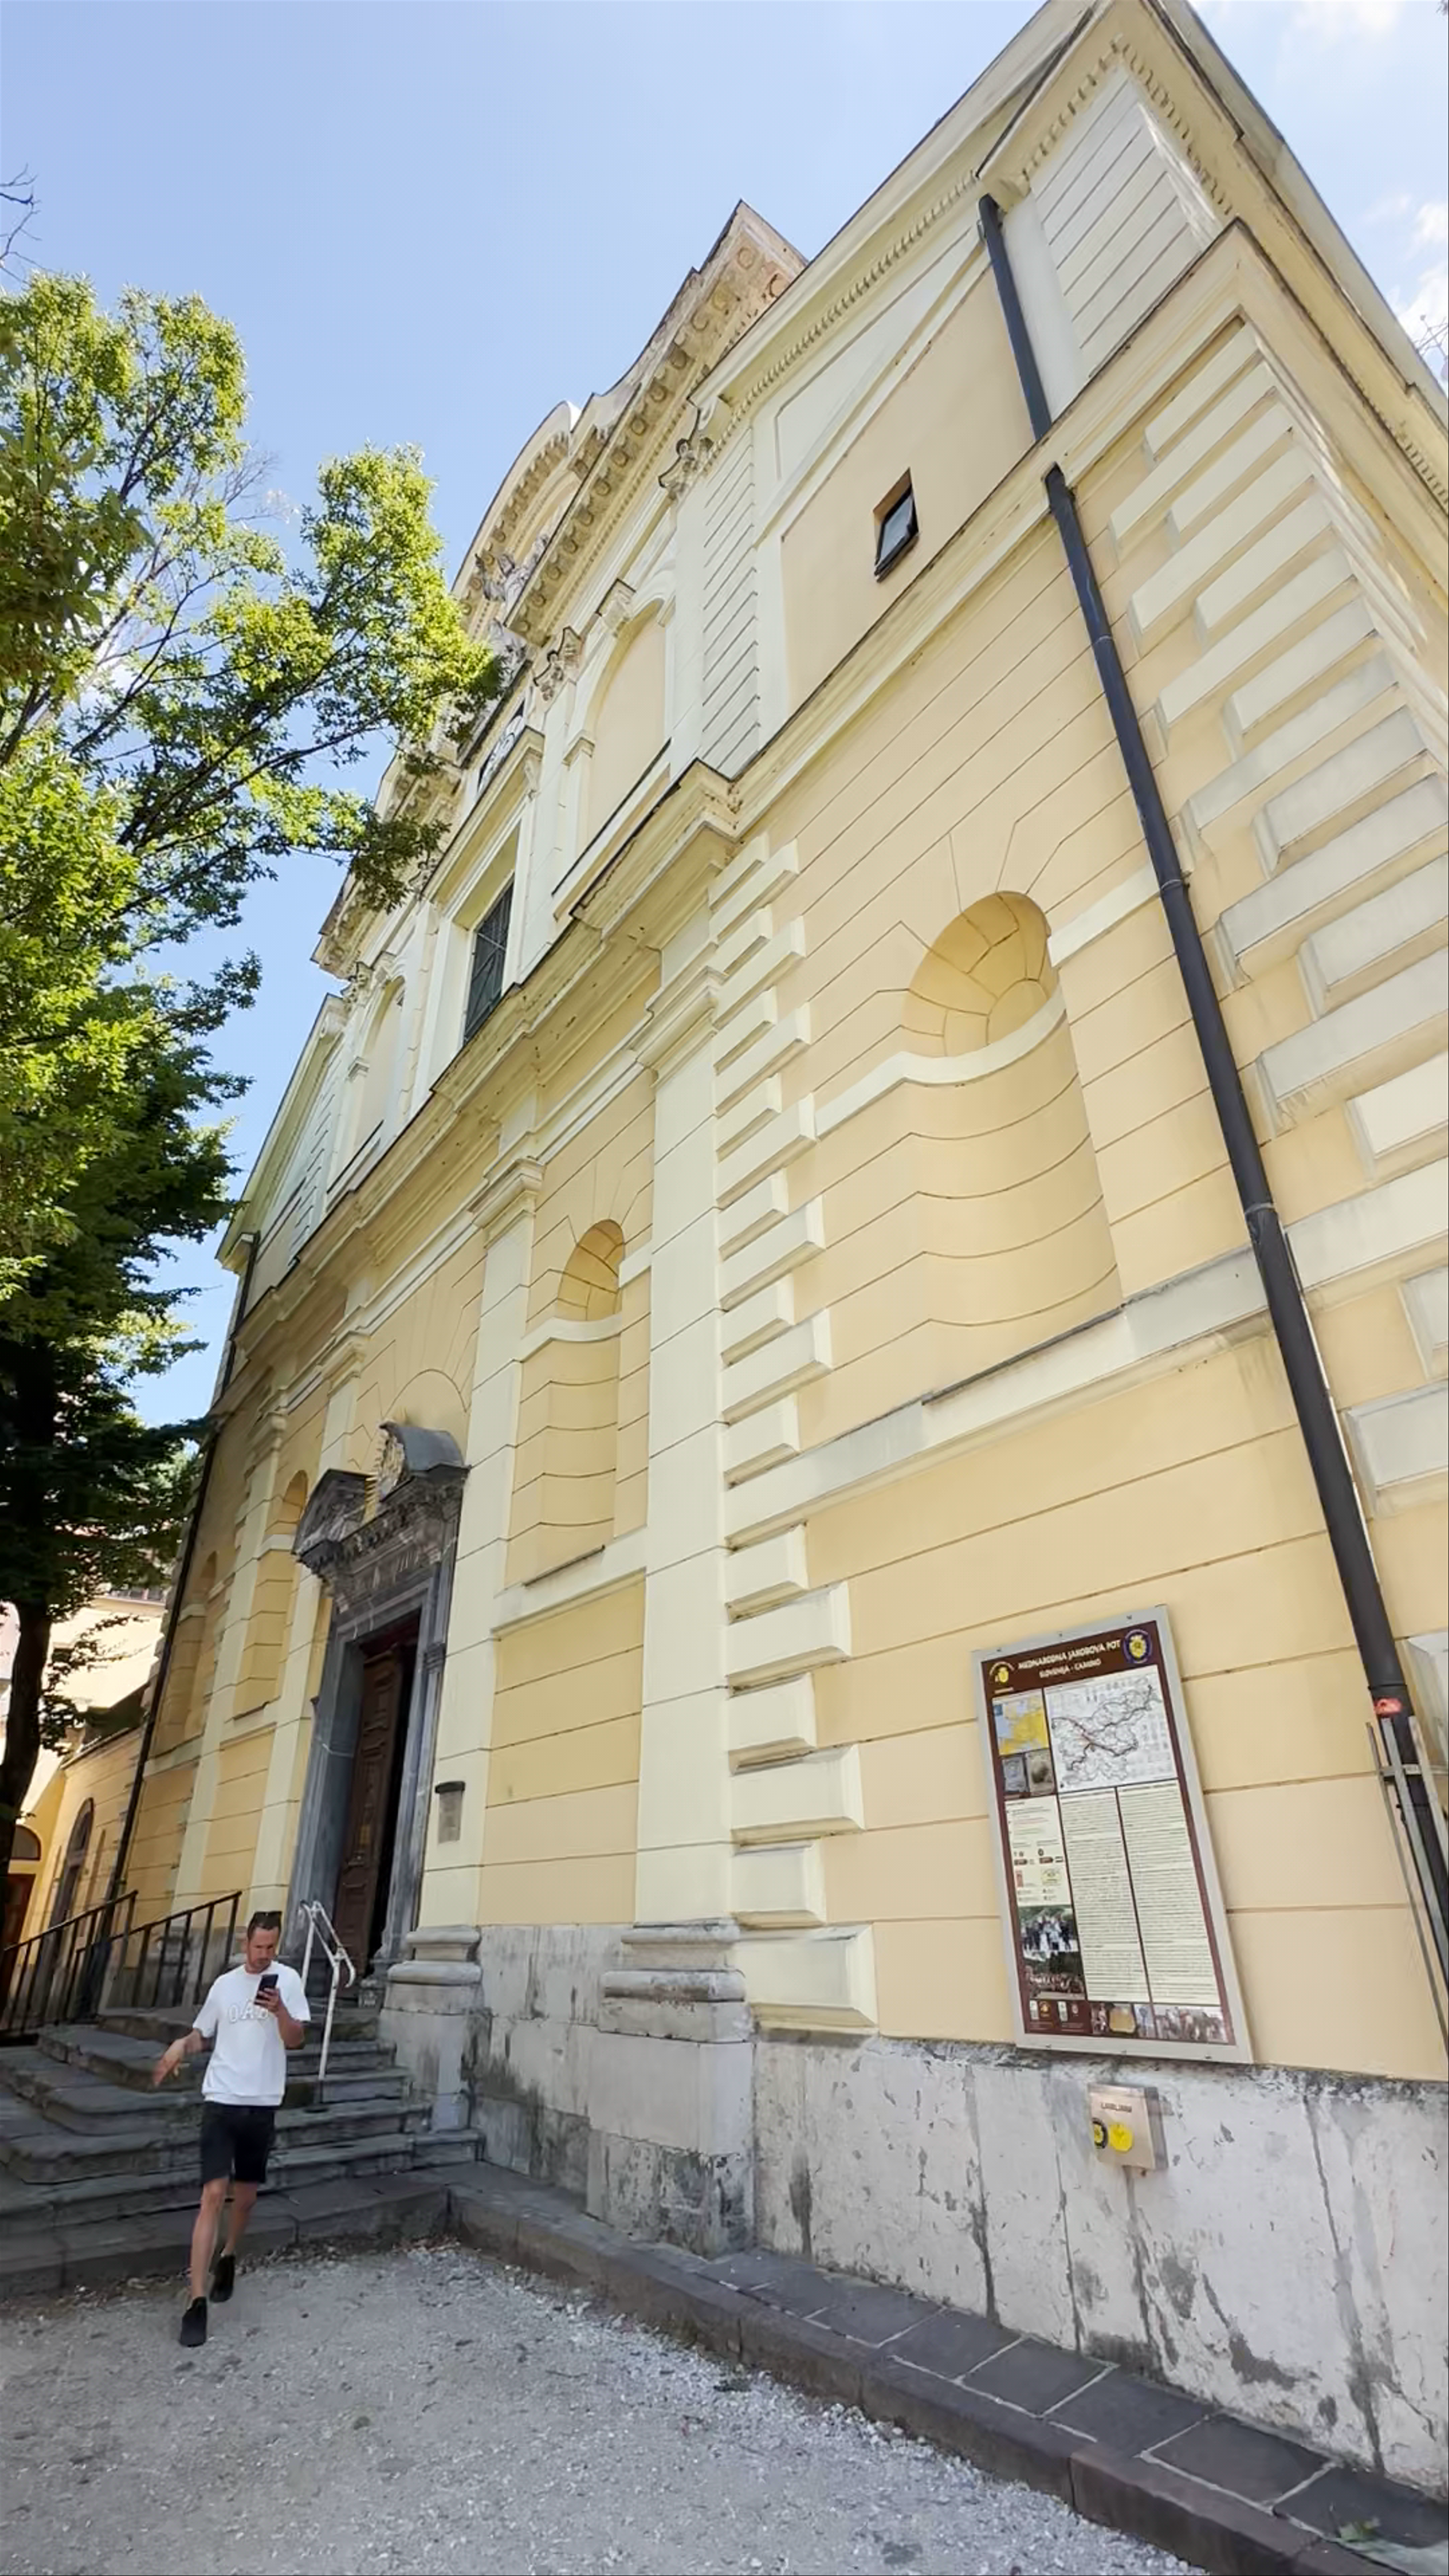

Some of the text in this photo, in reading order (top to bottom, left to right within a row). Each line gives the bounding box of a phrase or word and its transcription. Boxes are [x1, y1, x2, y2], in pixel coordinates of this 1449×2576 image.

[1018, 1652, 1067, 1669] MEDNARODNA
[1068, 1643, 1105, 1661] JAKOBOVA
[1106, 1639, 1121, 1650] POT
